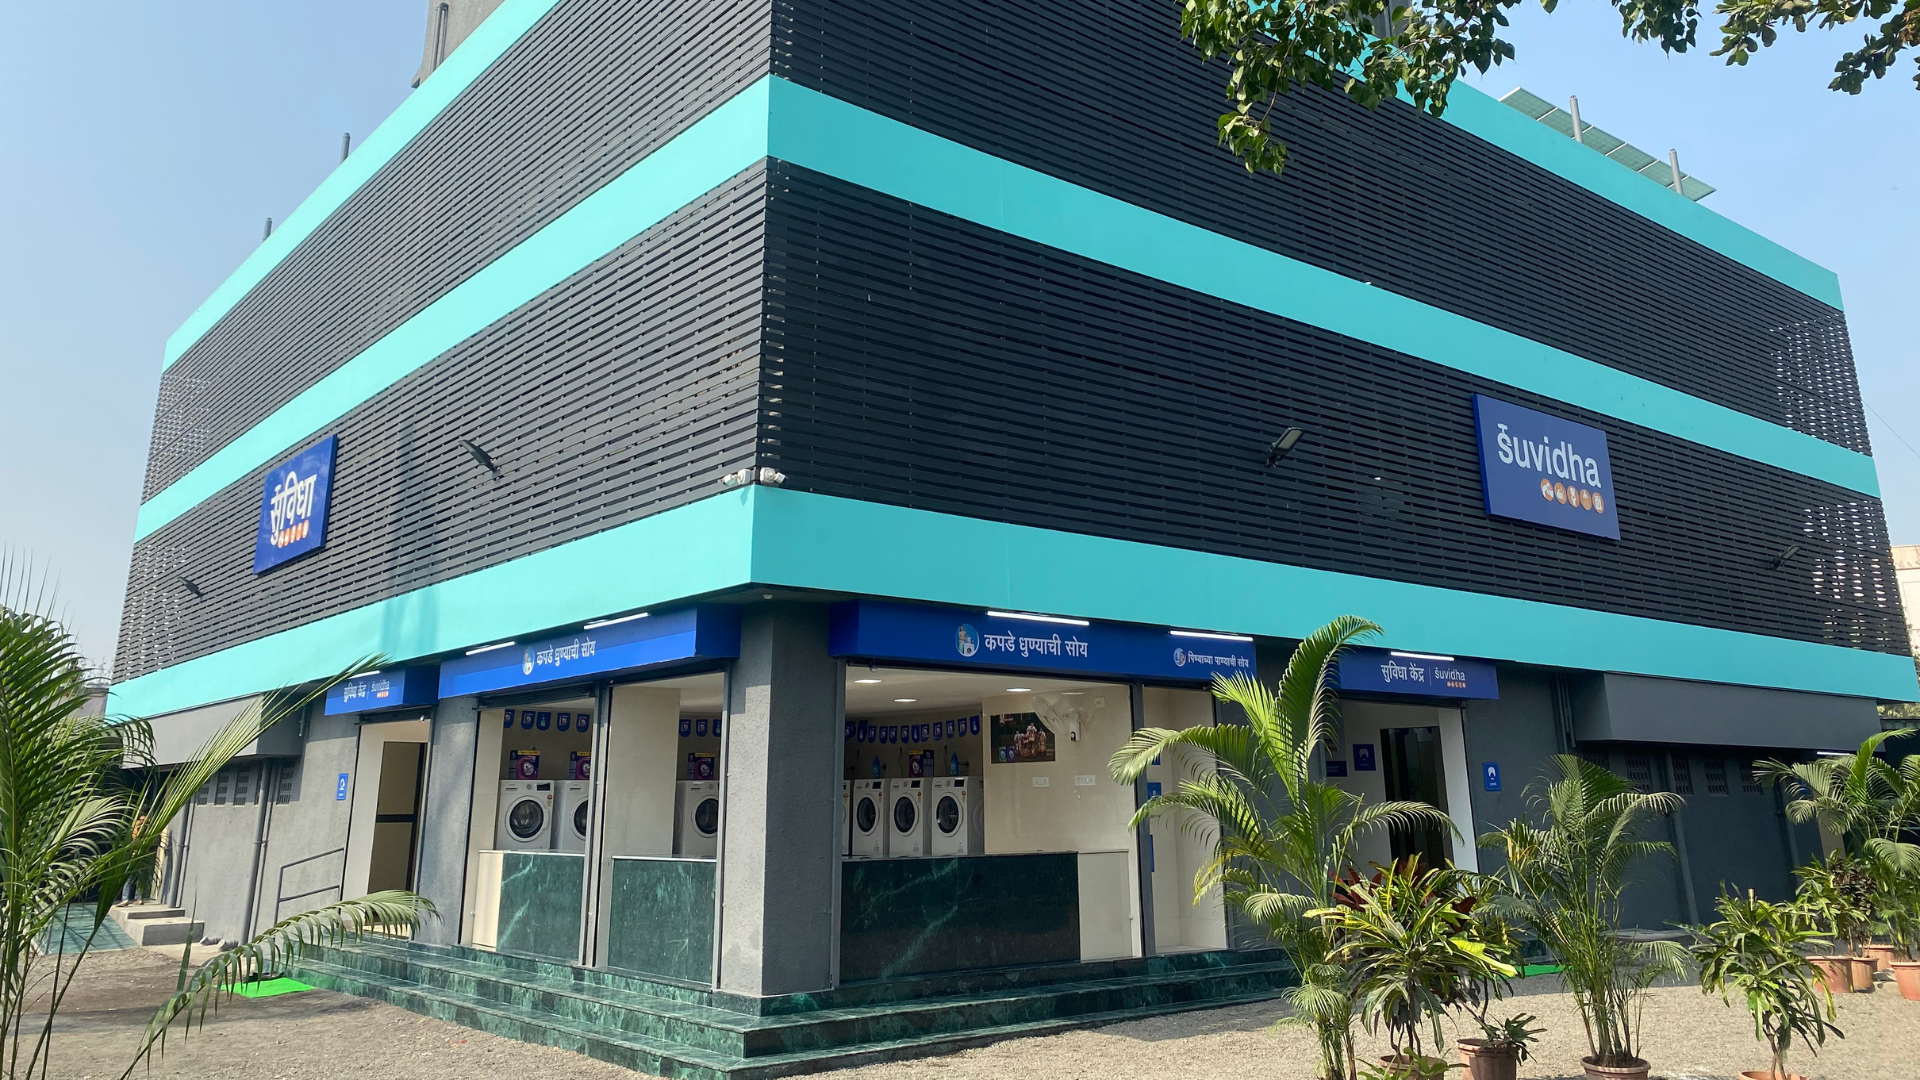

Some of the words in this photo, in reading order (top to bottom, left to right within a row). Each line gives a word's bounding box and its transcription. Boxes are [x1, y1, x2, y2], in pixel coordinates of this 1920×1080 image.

[270, 470, 317, 546] सुविधा
[536, 644, 554, 666] कपडे
[554, 638, 580, 667] धुण्याची
[581, 636, 596, 658] सोय
[984, 630, 1015, 652] कपडे
[1019, 634, 1061, 657] धुण्याची
[1064, 636, 1088, 658] सोय
[1237, 655, 1249, 668] सोय
[1381, 660, 1408, 683] सुविधा
[1408, 662, 1425, 682] केंद्र
